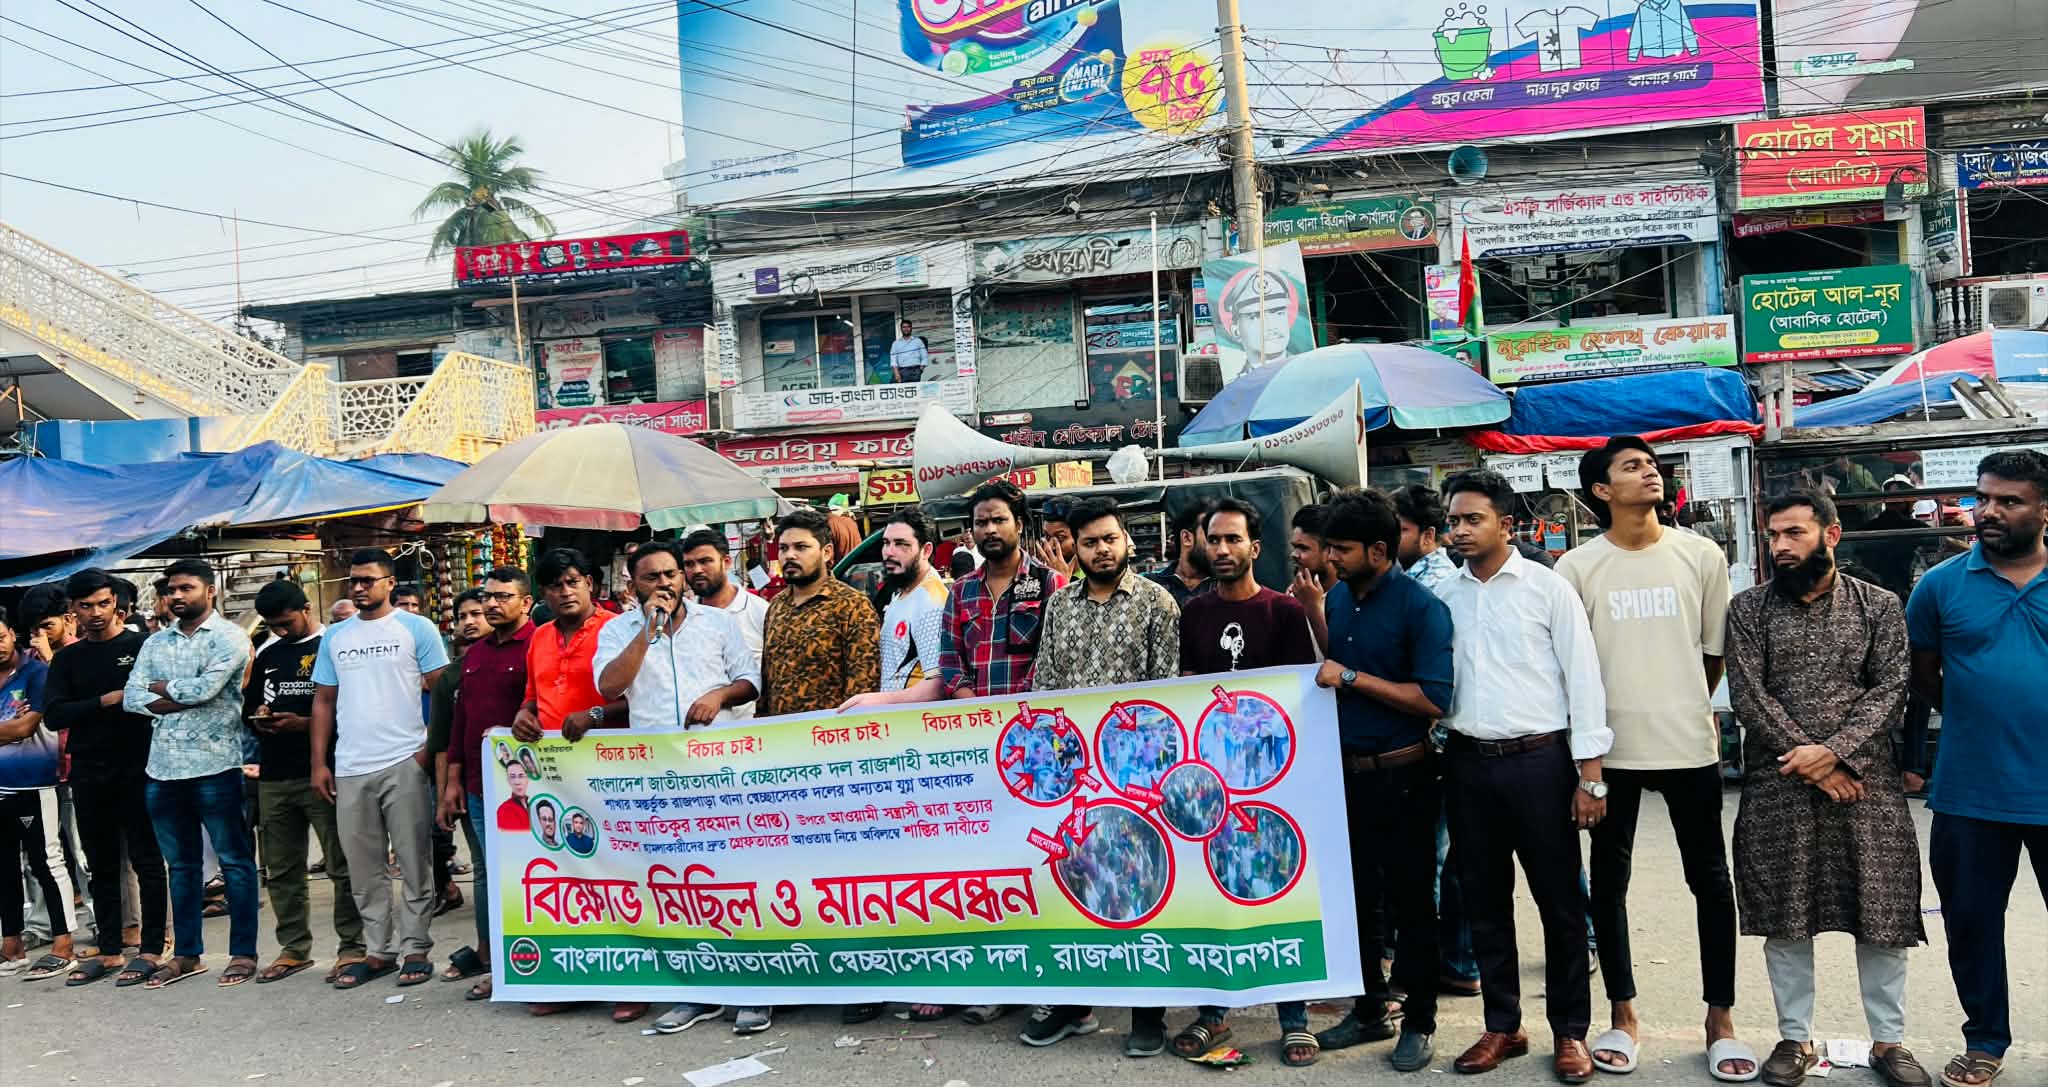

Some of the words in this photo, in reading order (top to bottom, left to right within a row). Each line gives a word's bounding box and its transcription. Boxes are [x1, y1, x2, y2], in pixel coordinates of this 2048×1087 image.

[1067, 63, 1105, 80] SMART
[1139, 62, 1206, 105] ৭৫
[1431, 92, 1460, 109] প্রচুর
[1462, 87, 1495, 102] ফেনা
[1526, 84, 1549, 96] দাগ
[1572, 78, 1600, 92] করে
[1745, 120, 1838, 160] হোটেল
[1843, 117, 1917, 157] সুমনা
[1263, 219, 1293, 235] জপাড়া
[1297, 217, 1317, 231] থানা
[1752, 285, 1818, 312] হোটেল
[1822, 282, 1903, 308] আল-নূর
[1653, 322, 1728, 346] কেয়ার
[1770, 311, 1832, 335] (আবাসিক
[1836, 308, 1888, 327] হোটেল)
[733, 438, 838, 465] জনপ্রিয়
[1608, 586, 1679, 621] SPIDER
[337, 645, 400, 662] CONTENT
[812, 725, 851, 746] বিচার
[922, 711, 963, 733] বিচার
[596, 744, 630, 761] বিচার
[688, 739, 724, 759] বিচার
[587, 775, 644, 794] বাংলাদেশ
[647, 768, 736, 792] জাতীয়তাবাদী
[741, 763, 823, 787] স্বেচ্ছাসেবক
[827, 759, 853, 778] দল
[859, 748, 921, 777] রাজশাহী
[928, 746, 991, 768] মহানগর
[671, 797, 717, 811] রাজপাড়া
[720, 793, 744, 807] থানা
[747, 784, 809, 806] স্বেচ্ছাসেবক
[812, 783, 845, 800] দলের
[849, 779, 893, 798] অন্যতম
[615, 818, 632, 834] এম
[637, 813, 691, 843] আতিকুর
[695, 812, 741, 831] রহমান
[829, 804, 880, 826] আওয়ামী
[955, 799, 993, 814] হত্যার
[729, 833, 789, 850] গ্রেফতারের
[792, 829, 832, 847] আওতায়
[835, 827, 857, 843] নিয়ে
[944, 817, 991, 838] দাবীতে
[522, 857, 643, 926] বিক্ষোভ
[647, 863, 760, 938] মিছিল
[771, 879, 801, 928] ও
[811, 867, 1037, 927] মানববন্ধন
[551, 946, 660, 975] বাংলাদেশ
[663, 942, 819, 976] জাতীয়তাবাদী
[829, 945, 976, 976] স্বেচ্ছাসেবক
[1050, 933, 1174, 975] রাজশাহী
[1180, 936, 1304, 976] মহানগর
